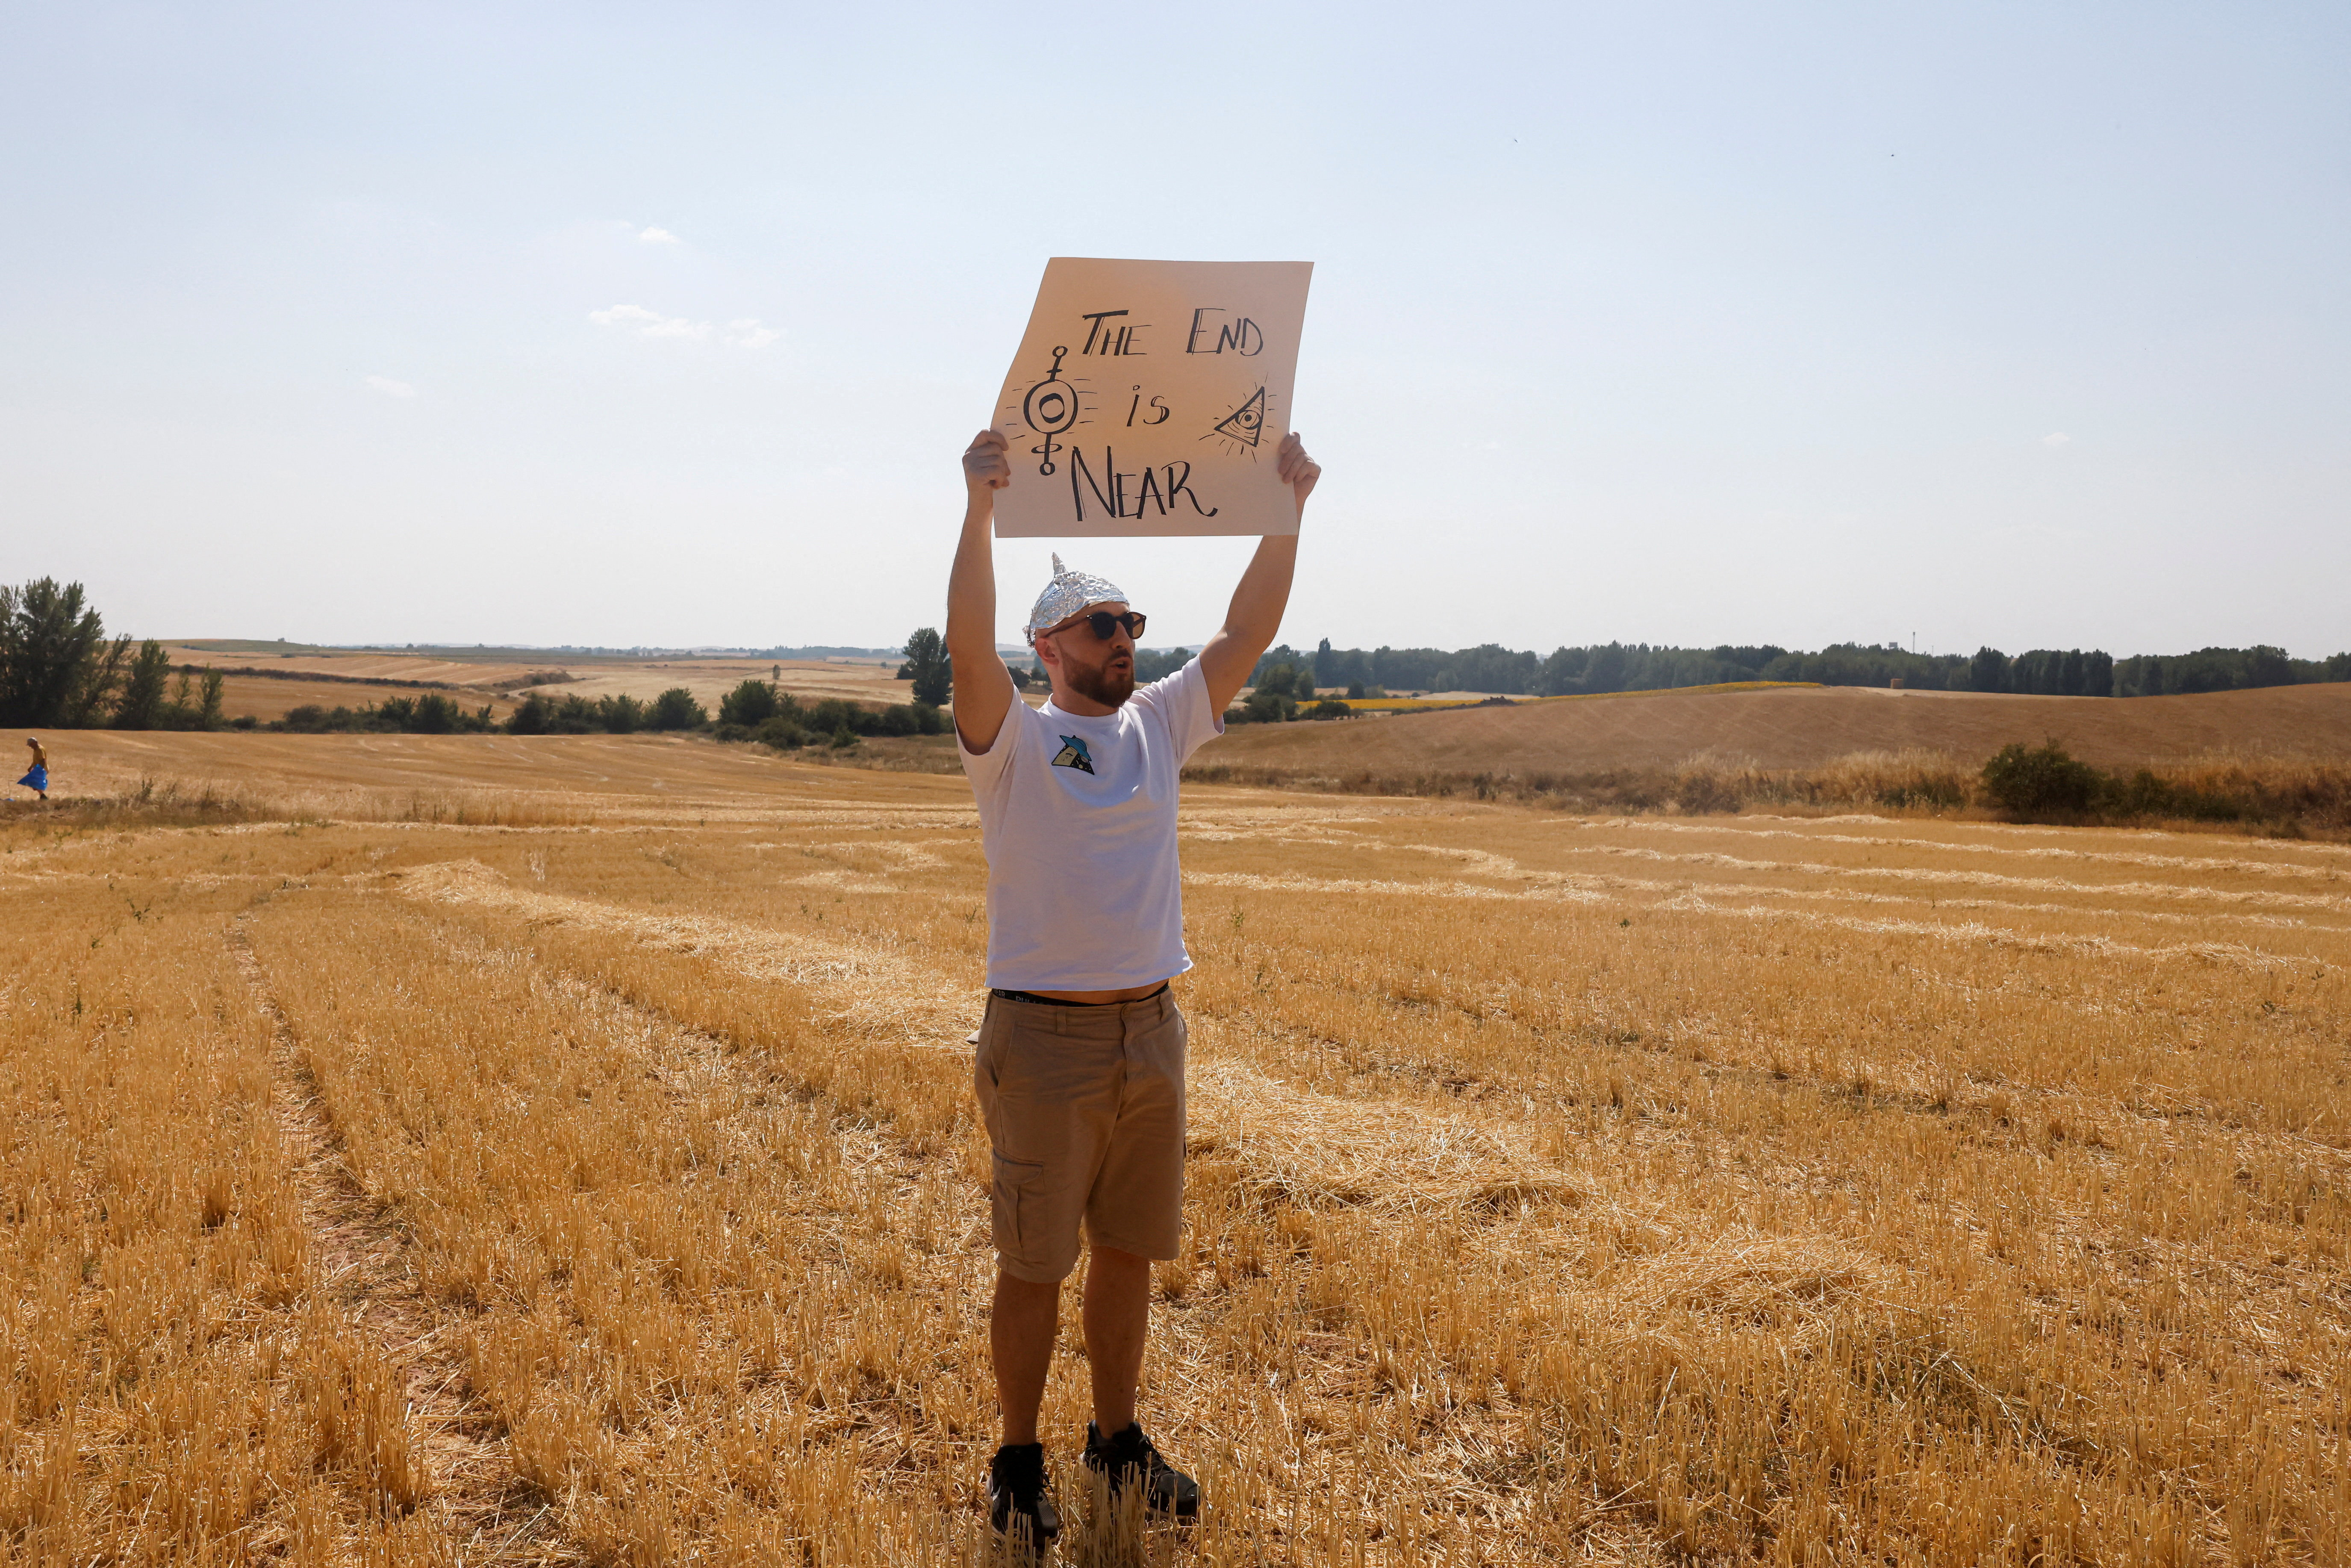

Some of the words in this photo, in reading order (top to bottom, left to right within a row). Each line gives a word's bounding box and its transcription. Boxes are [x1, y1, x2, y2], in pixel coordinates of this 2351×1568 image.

[1082, 309, 1152, 357] THE
[1186, 308, 1264, 356] END
[1126, 385, 1170, 427] is
[1071, 445, 1218, 522] NEAR
